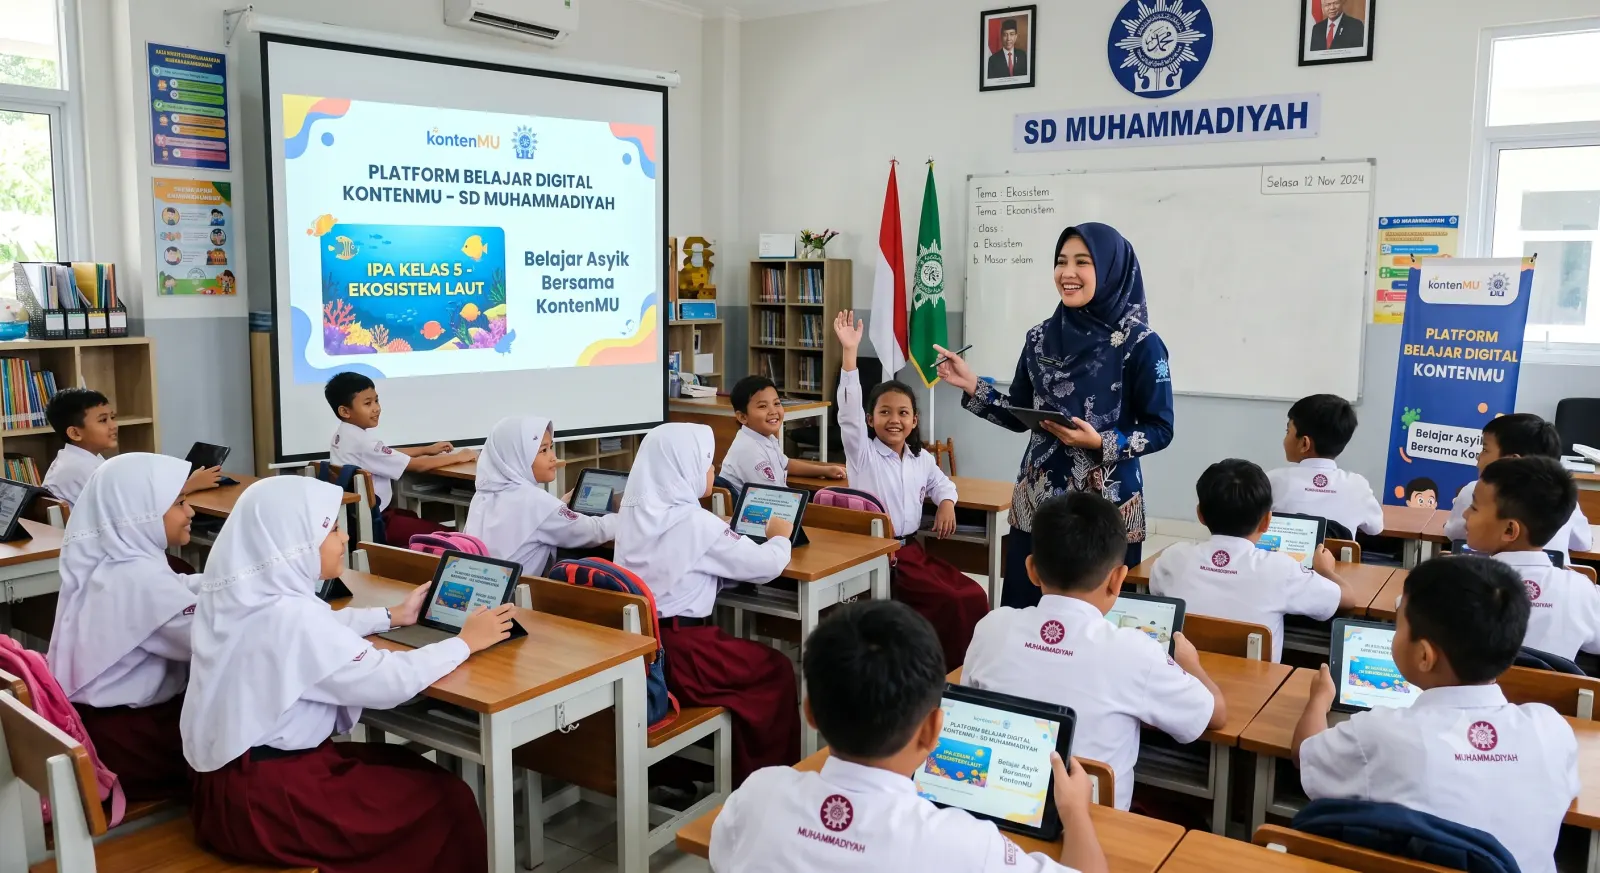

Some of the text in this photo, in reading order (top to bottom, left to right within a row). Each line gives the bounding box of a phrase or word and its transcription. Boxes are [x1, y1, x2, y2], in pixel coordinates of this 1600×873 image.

[1024, 102, 1308, 144] SD MUHAMMADIYAH
[426, 130, 500, 149] kontenMU
[368, 164, 593, 189] PLATFORM BELAJAR DIGITAL
[1267, 174, 1364, 187] Selasa 12 Nov 2024
[343, 186, 442, 204] KONTENMU
[459, 190, 480, 205] SD
[484, 191, 615, 210] MUHAMMADIYAH
[976, 187, 997, 198] Tema
[1006, 186, 1049, 198] Ekosistem
[976, 205, 997, 216] Tema
[984, 238, 1022, 248] Ekosistem
[525, 250, 630, 271] Belajar Asyik
[367, 263, 395, 276] IPA
[400, 262, 450, 277] KELAS
[453, 263, 463, 276] 5
[348, 282, 484, 296] EKOSISTEM LAUT
[542, 275, 614, 290] Bersama
[1428, 280, 1480, 289] kontenMU
[536, 297, 619, 313] KontenMU
[1426, 328, 1498, 342] PLATFORM
[1404, 344, 1518, 362] BELAJAR DIGITAL
[1414, 363, 1505, 382] KONTENMU
[1416, 429, 1453, 443] Belajar
[1411, 442, 1458, 456] Bersama
[1024, 642, 1074, 657] MUHAMMADIYAH
[950, 722, 1031, 744] PLATFORM BELAJAR DIGITAL
[989, 738, 1038, 752] MUHAMMADIYAH
[797, 826, 866, 853] MUHAMMADIYAH
